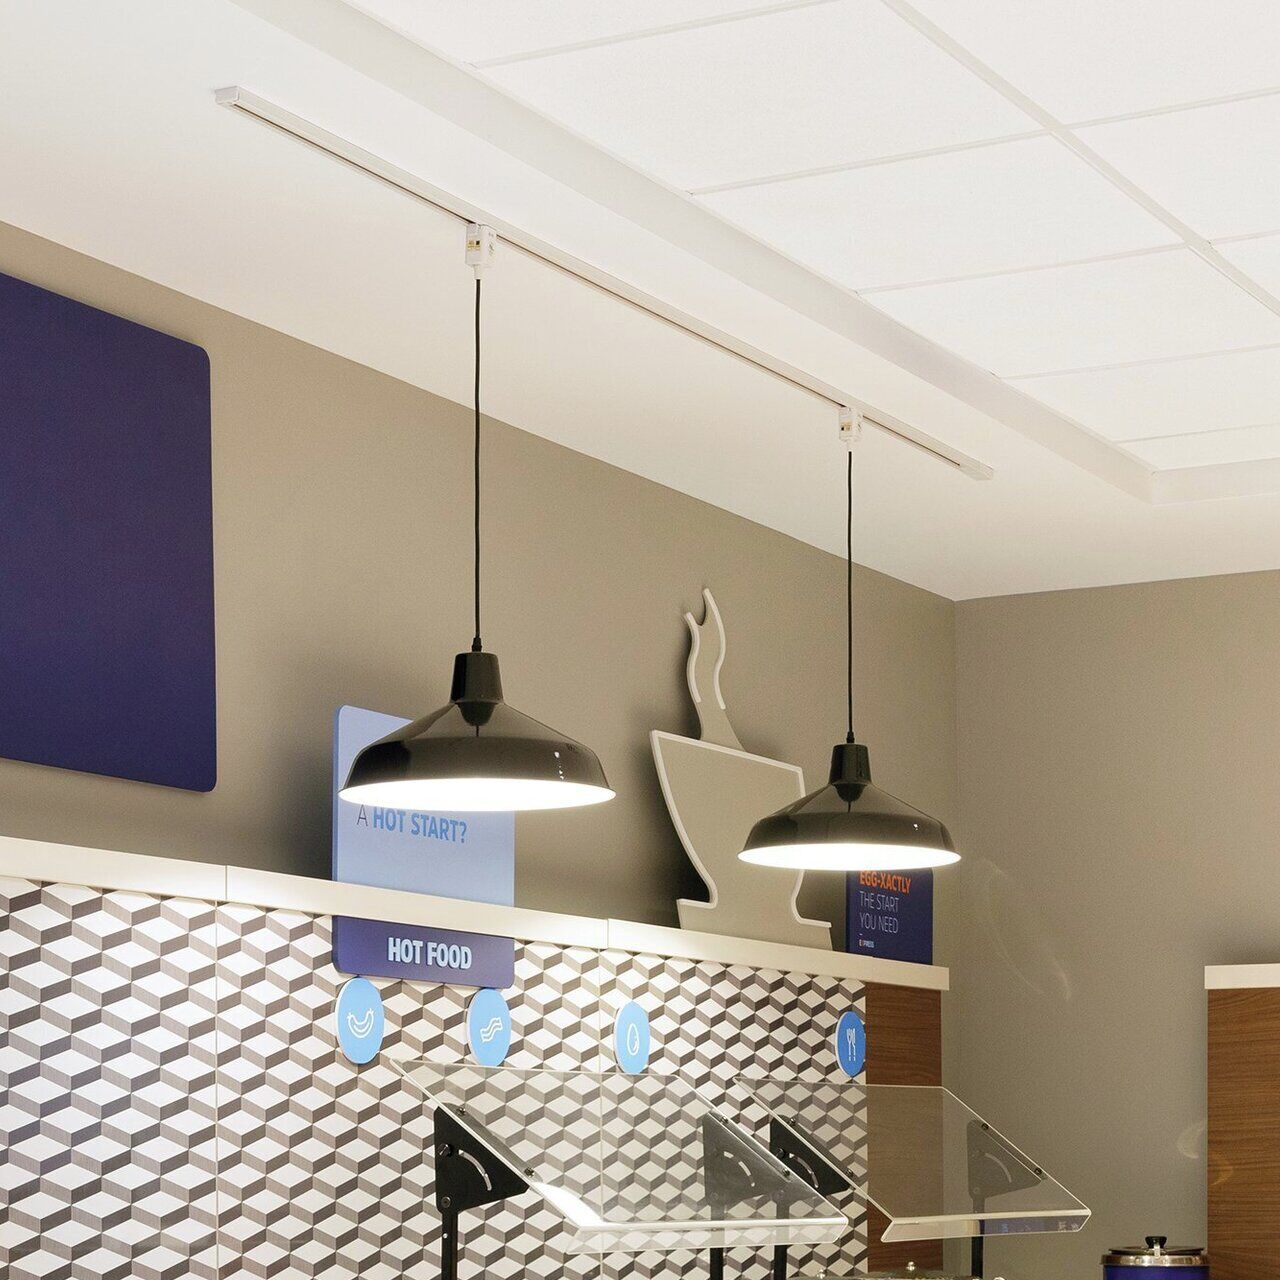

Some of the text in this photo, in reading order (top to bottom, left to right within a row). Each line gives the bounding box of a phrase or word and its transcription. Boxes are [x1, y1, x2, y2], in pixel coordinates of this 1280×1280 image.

[356, 804, 468, 843] A HOT START?
[858, 870, 912, 895] EGG-XACTLY
[859, 890, 900, 913] THE START
[859, 911, 899, 934] YOU NEED
[387, 937, 472, 970] HOT FOOD
